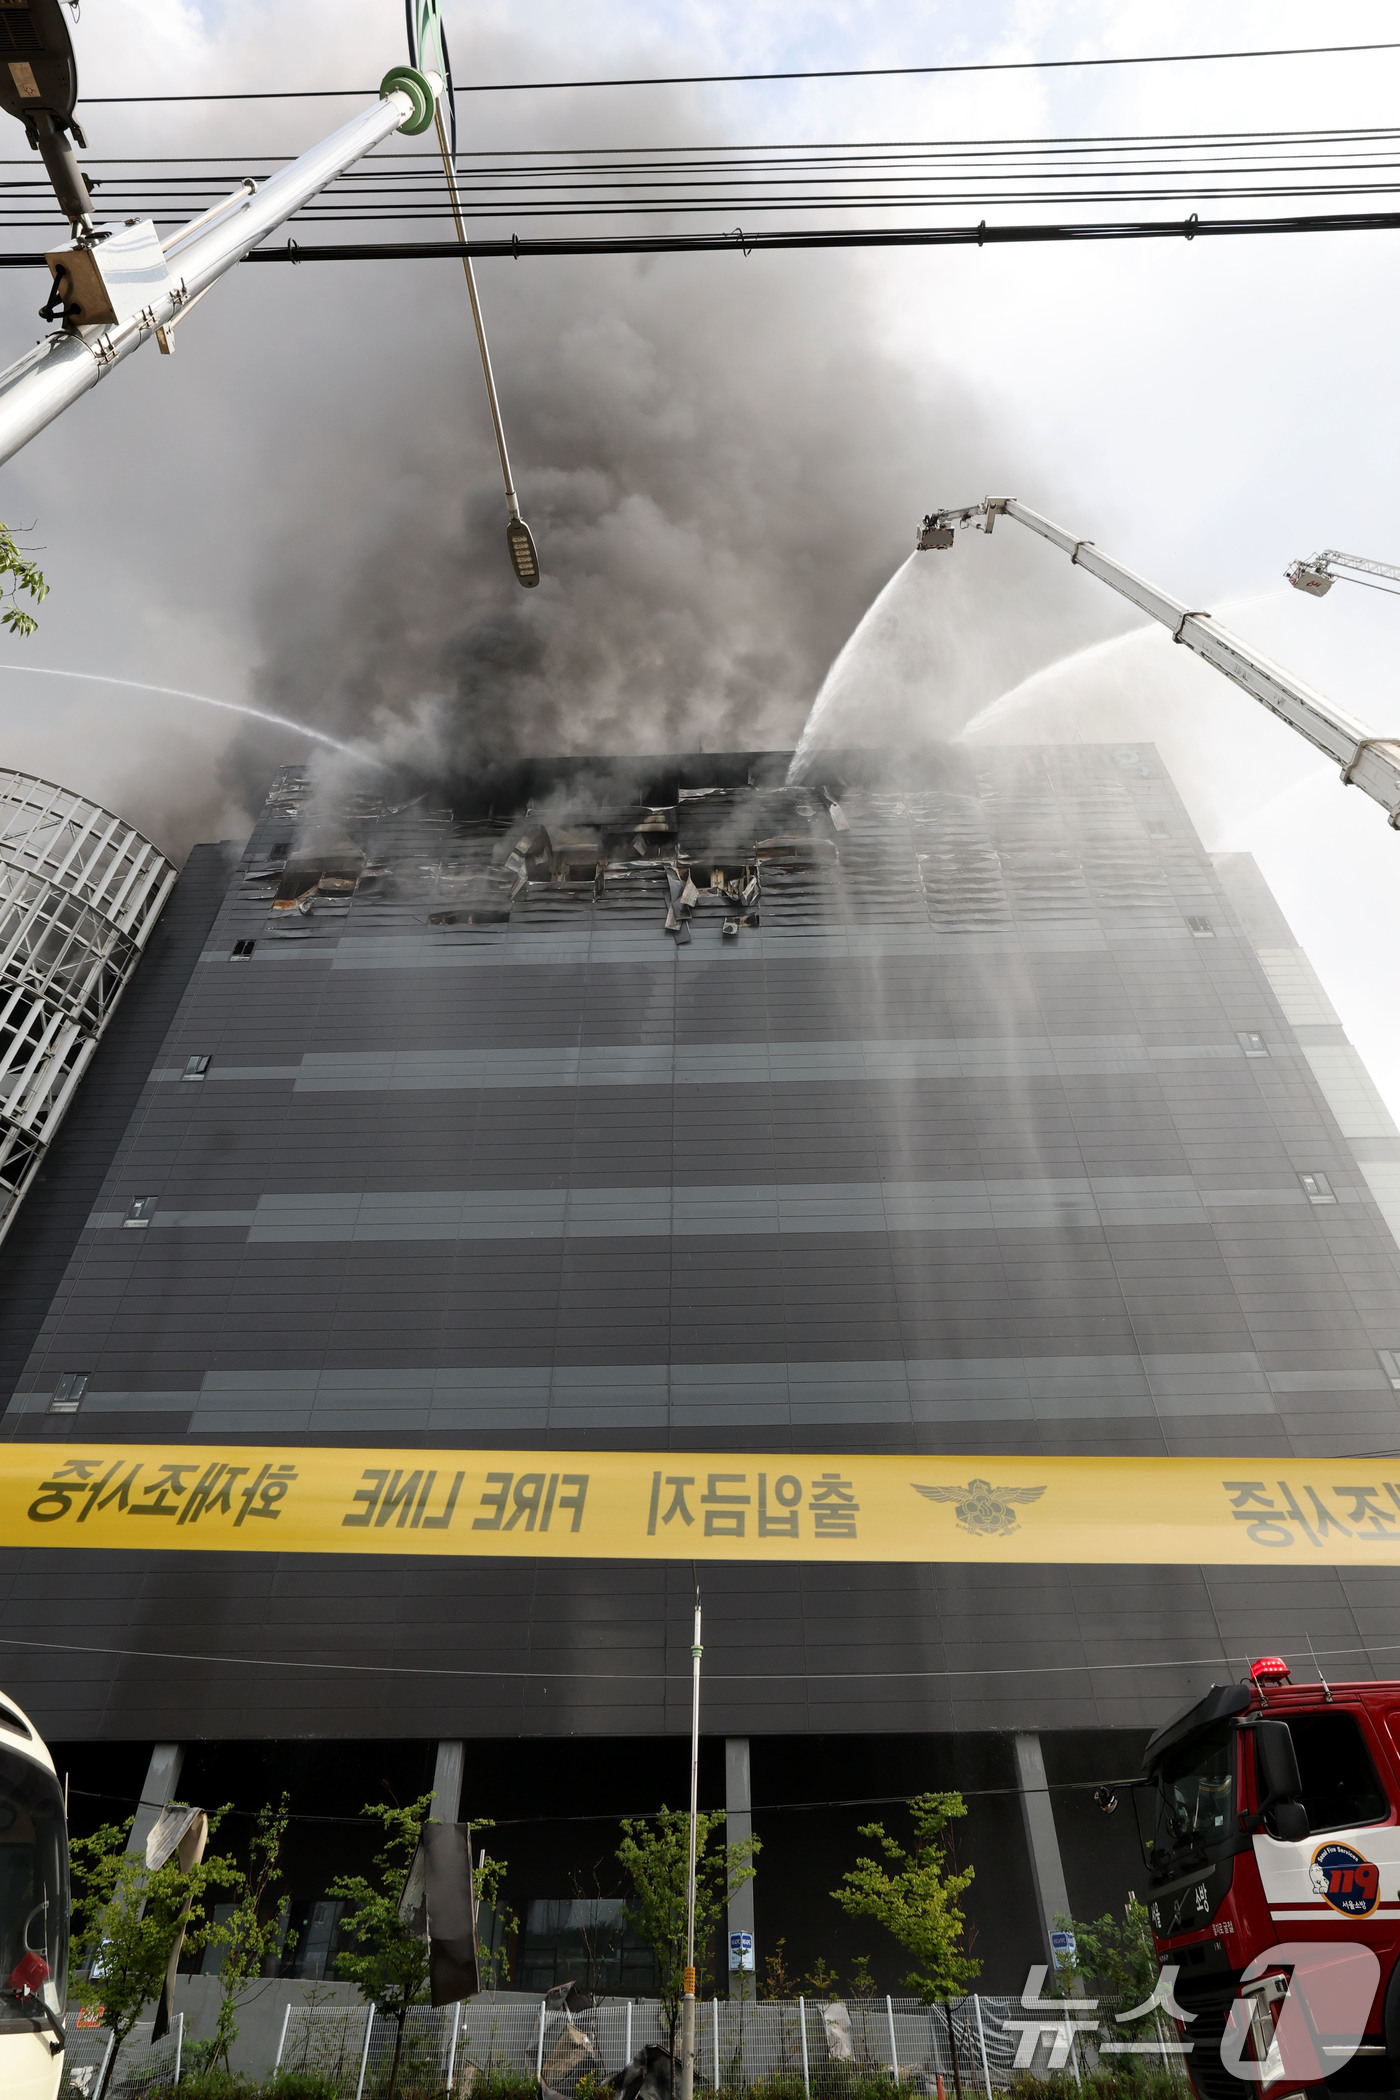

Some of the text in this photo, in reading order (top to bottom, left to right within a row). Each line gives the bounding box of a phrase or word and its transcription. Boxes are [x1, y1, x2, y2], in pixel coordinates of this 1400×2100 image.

[1329, 1862, 1379, 1899] 119
[1195, 1882, 1210, 1913] 소방
[1342, 1900, 1367, 1910] 서울소방
